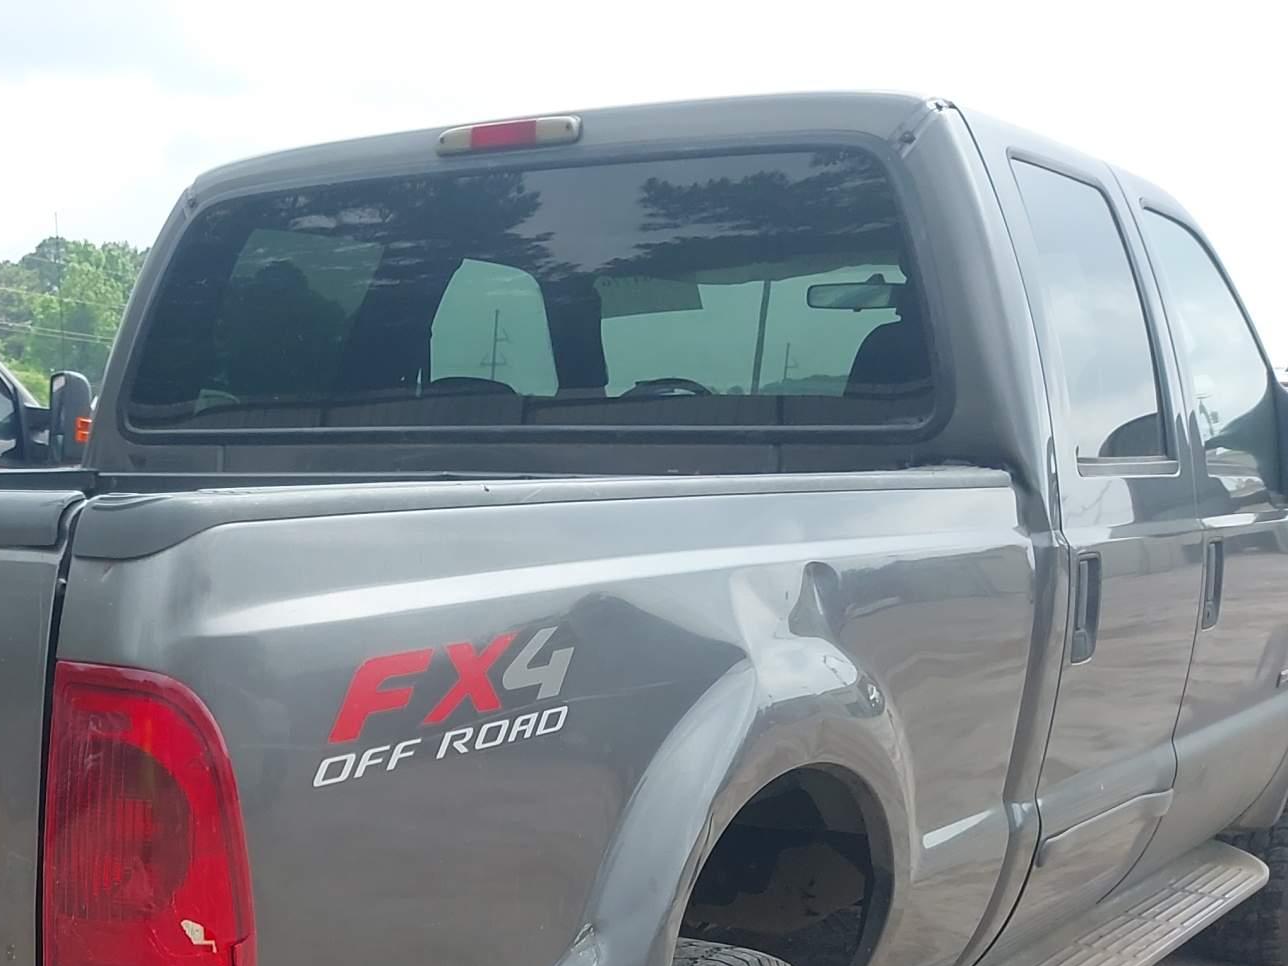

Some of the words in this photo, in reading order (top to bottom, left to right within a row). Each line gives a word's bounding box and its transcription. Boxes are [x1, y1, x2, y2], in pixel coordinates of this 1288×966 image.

[327, 625, 575, 745] FX4
[312, 738, 422, 788] OFF
[435, 705, 569, 760] ROAD
